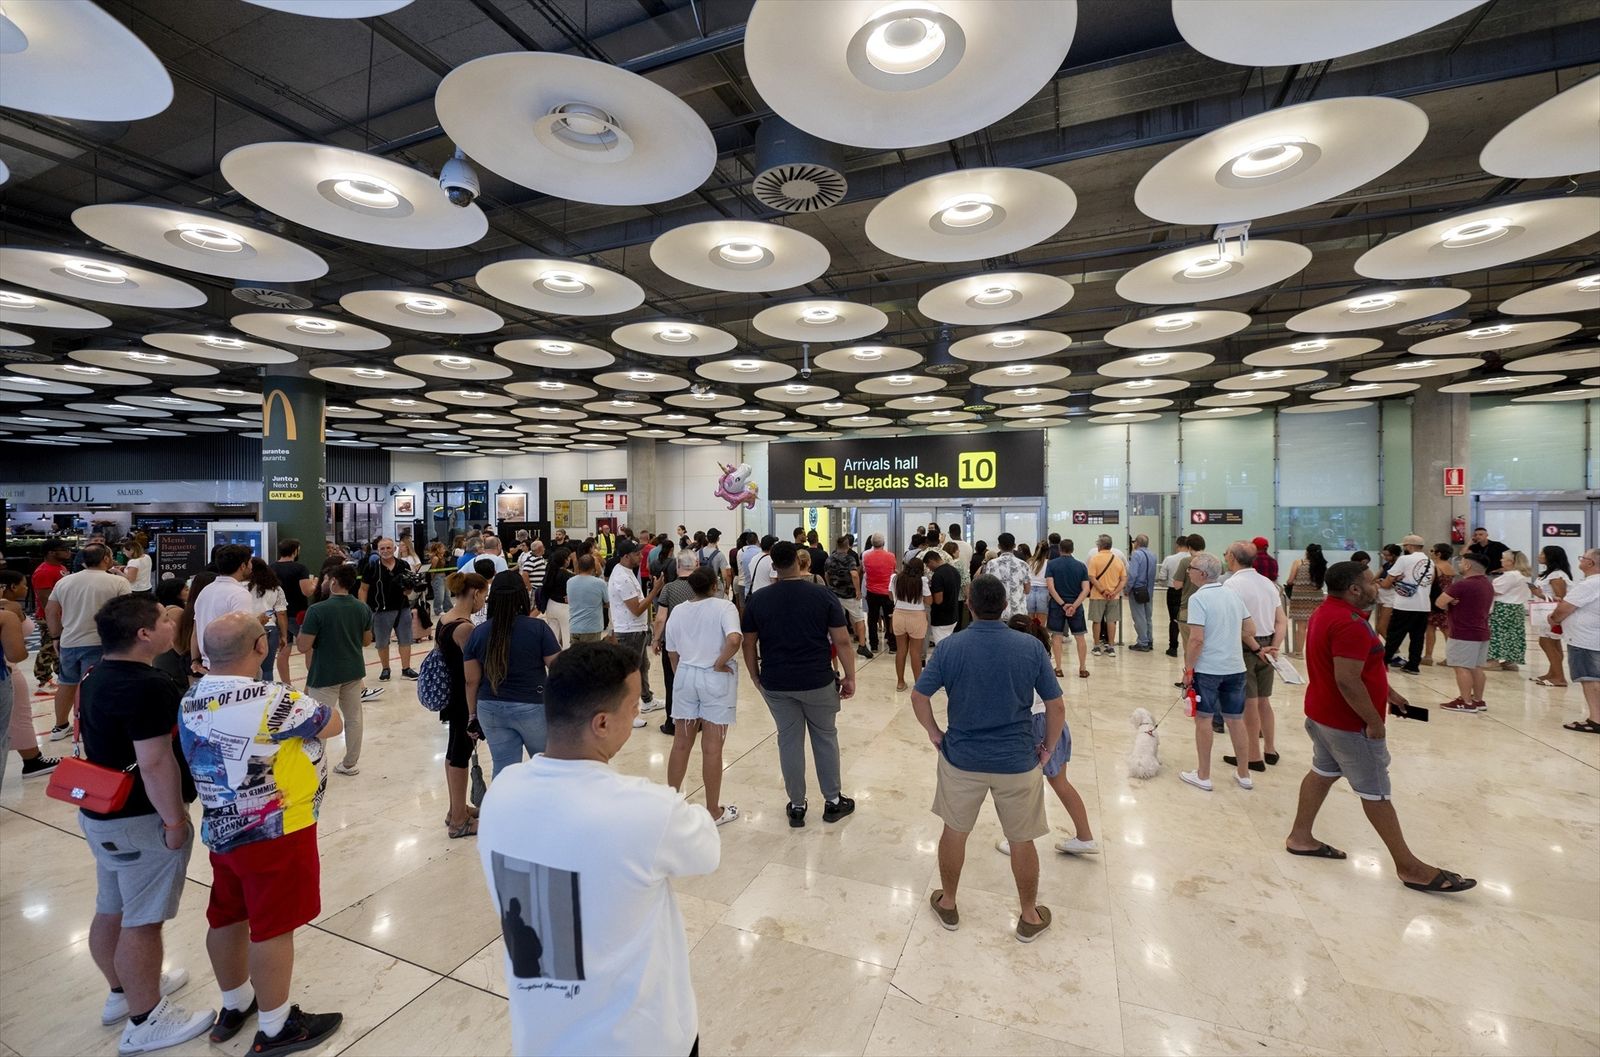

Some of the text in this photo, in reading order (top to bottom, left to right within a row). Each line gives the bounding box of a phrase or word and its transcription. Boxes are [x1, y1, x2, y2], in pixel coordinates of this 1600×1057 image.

[843, 456, 918, 471] Arrivals hall
[962, 459, 993, 482] 10
[844, 473, 949, 492] Llegadas Sala
[48, 486, 94, 502] PAUL
[326, 486, 385, 502] PAUL
[218, 692, 233, 706] OF
[235, 685, 267, 702] LOVE
